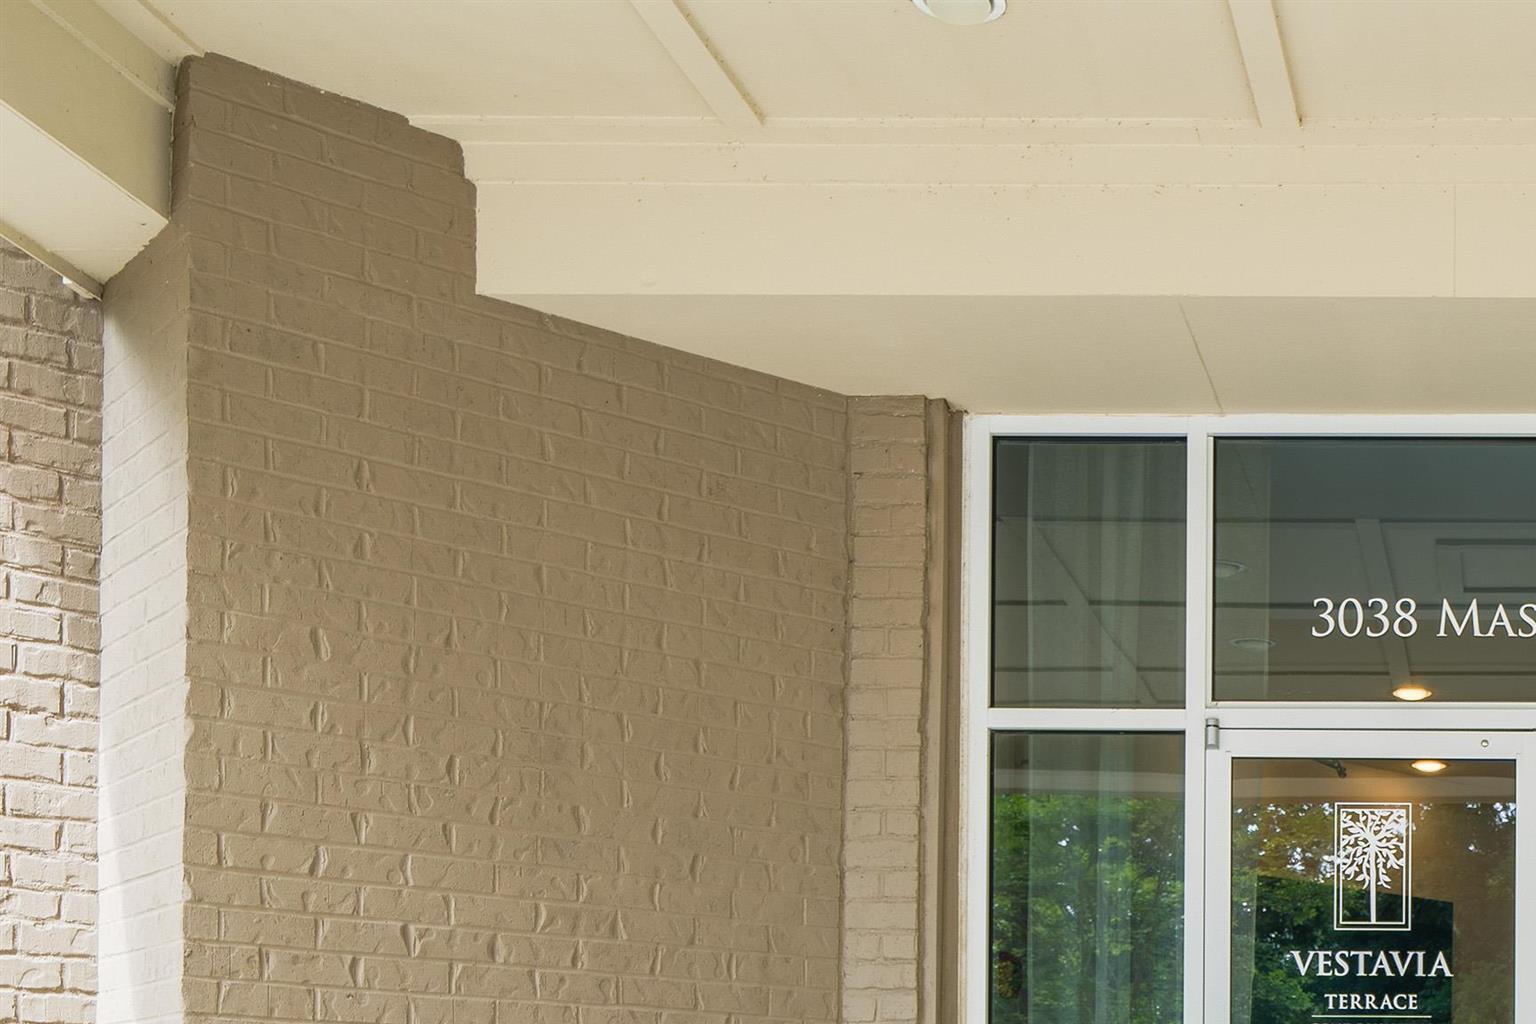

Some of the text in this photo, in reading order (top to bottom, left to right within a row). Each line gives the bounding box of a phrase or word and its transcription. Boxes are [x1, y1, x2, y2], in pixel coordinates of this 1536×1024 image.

[1311, 597, 1418, 638] 3038
[1291, 950, 1455, 978] VESTAVIA
[1323, 993, 1418, 1010] TERRACE
